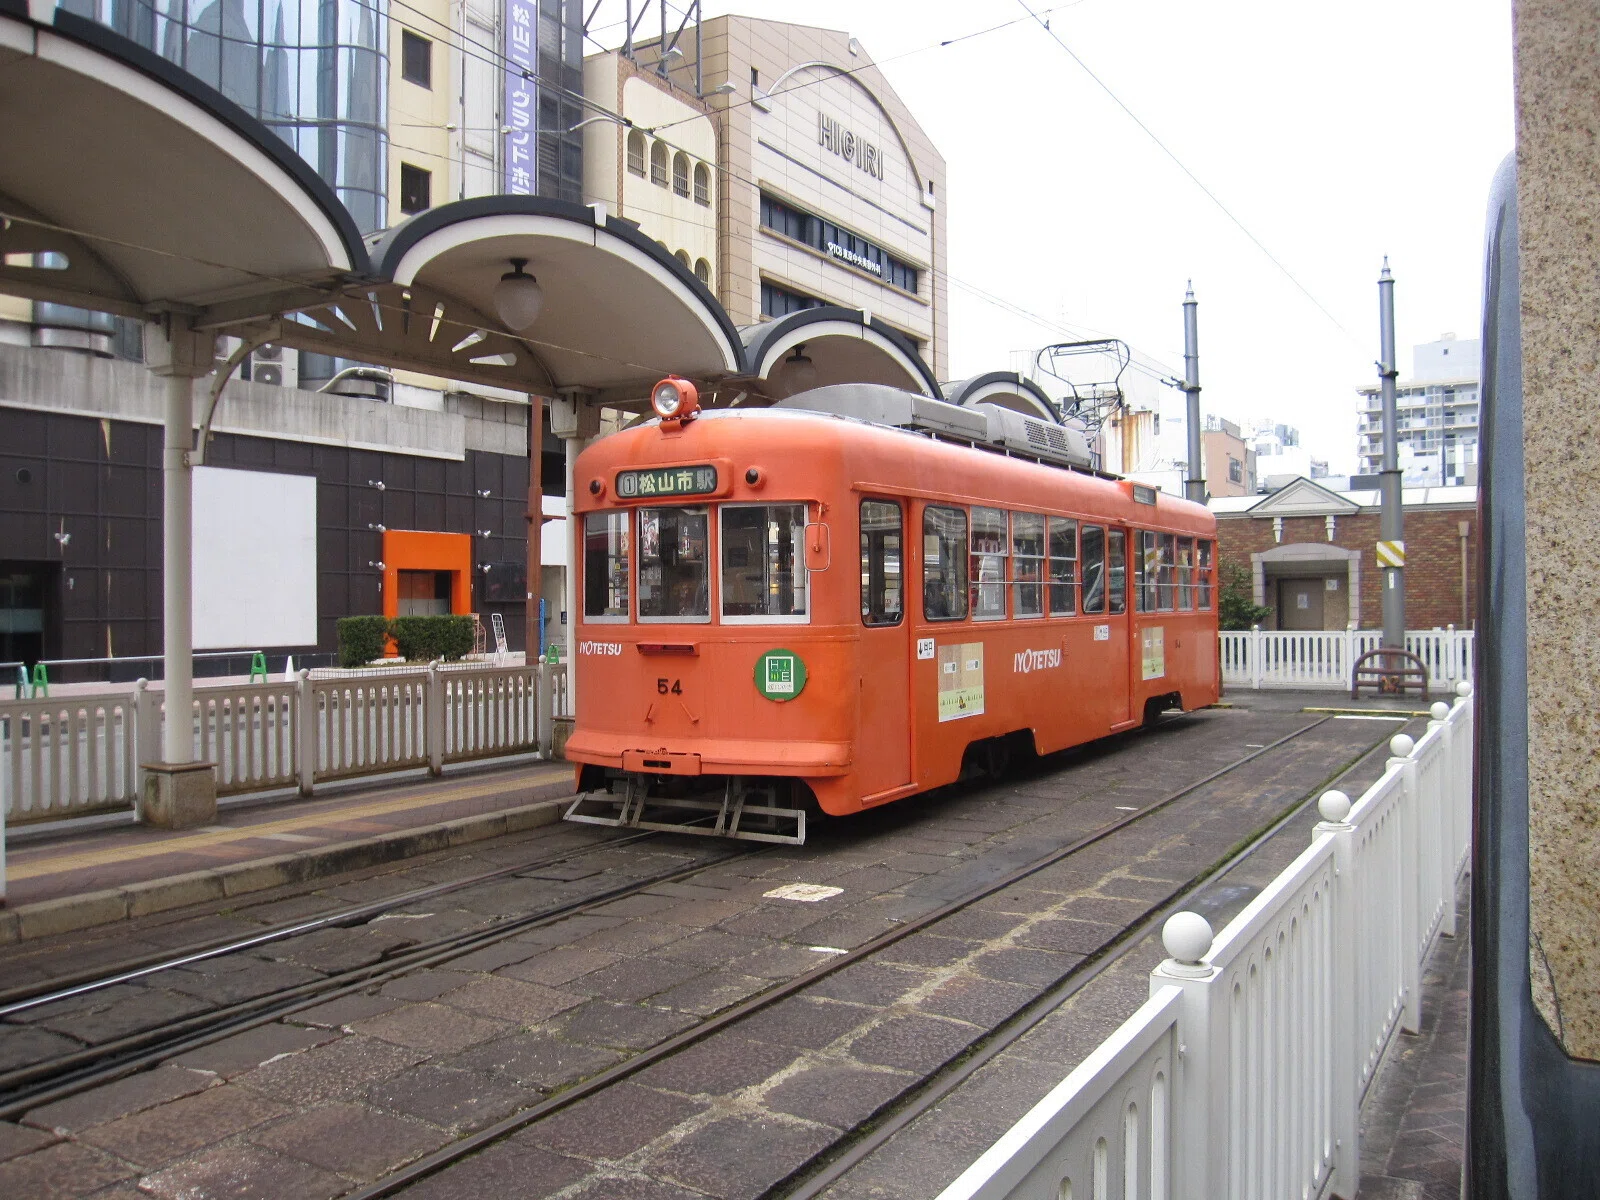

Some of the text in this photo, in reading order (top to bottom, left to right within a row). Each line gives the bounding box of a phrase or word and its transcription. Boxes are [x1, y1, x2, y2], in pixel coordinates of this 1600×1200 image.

[818, 111, 883, 181] HIGIRI
[638, 469, 714, 494] 松山市駅
[580, 640, 622, 656] IYOTETSU
[1013, 648, 1061, 673] IYOTETSU
[657, 678, 682, 695] 54
